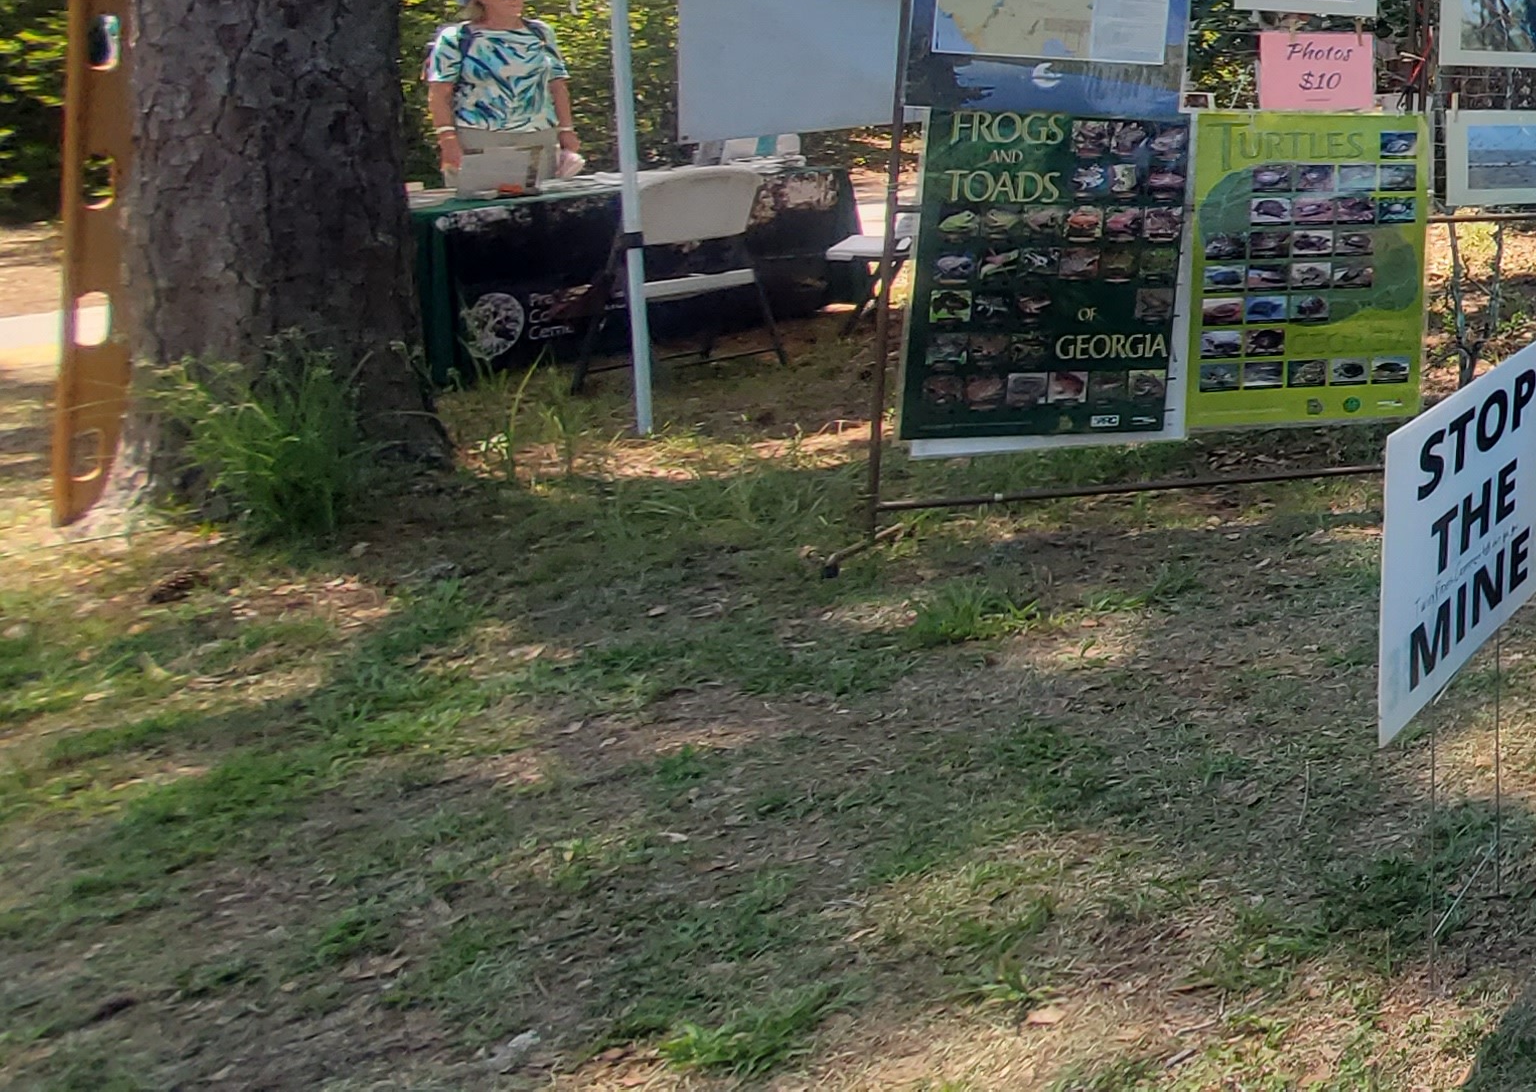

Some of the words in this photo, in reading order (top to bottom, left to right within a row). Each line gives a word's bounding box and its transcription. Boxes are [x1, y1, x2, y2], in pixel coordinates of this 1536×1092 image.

[1286, 41, 1353, 62] Photos
[1298, 70, 1342, 91] $10
[950, 111, 1066, 145] FROGS
[989, 149, 1023, 164] AND
[1206, 121, 1365, 172] TURTLES
[944, 170, 1061, 203] TOADS
[1077, 308, 1098, 322] OF
[1055, 333, 1168, 360] GEORGIA
[1417, 368, 1536, 502] STOP
[1431, 457, 1518, 576] THE
[1409, 526, 1531, 693] MINE
